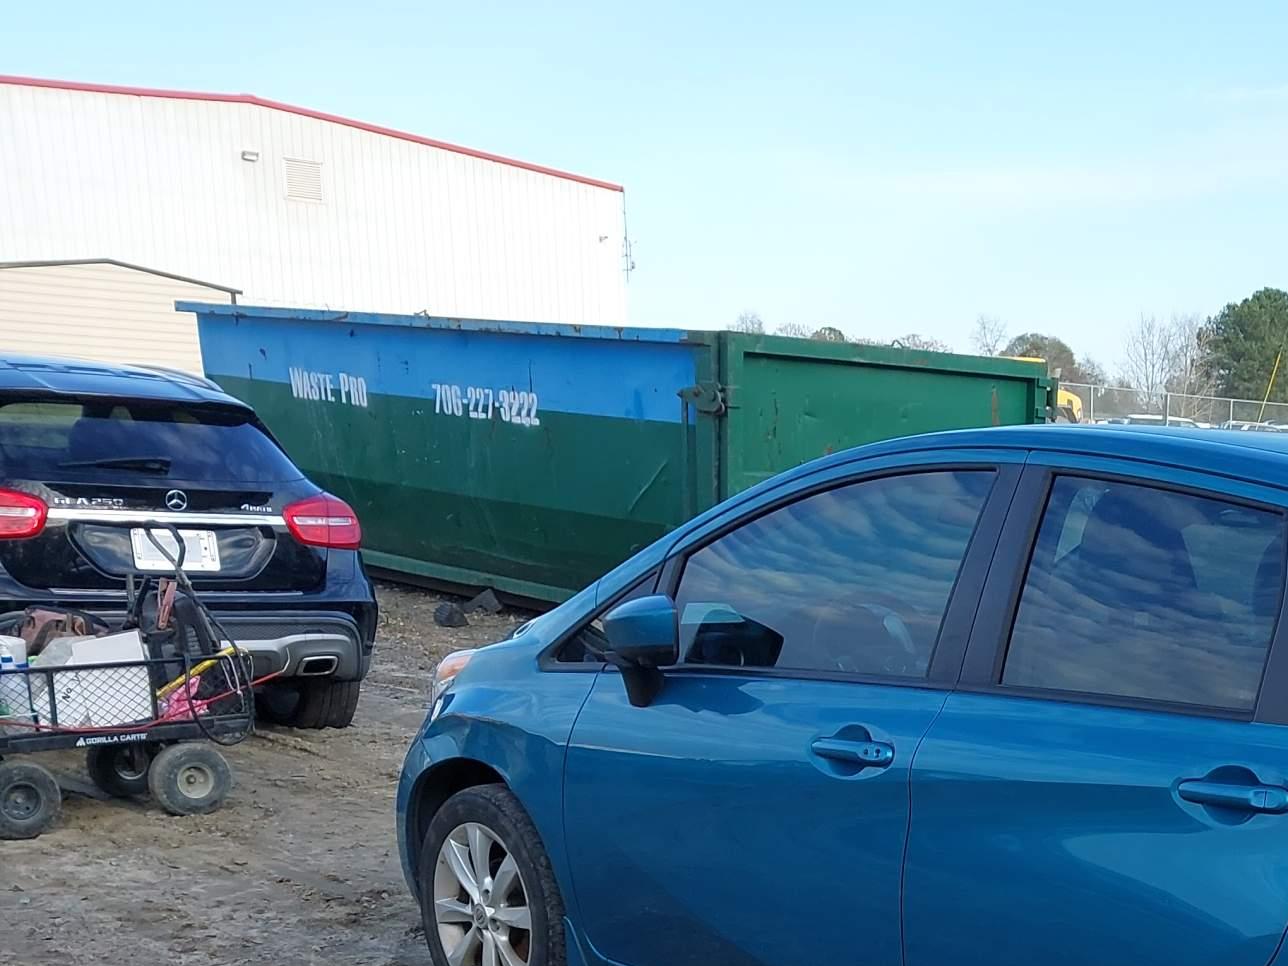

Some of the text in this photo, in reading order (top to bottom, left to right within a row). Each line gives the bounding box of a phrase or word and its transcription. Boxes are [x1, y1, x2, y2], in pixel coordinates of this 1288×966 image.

[289, 367, 368, 408] WASTE PRO
[86, 736, 119, 745] GORILLA
